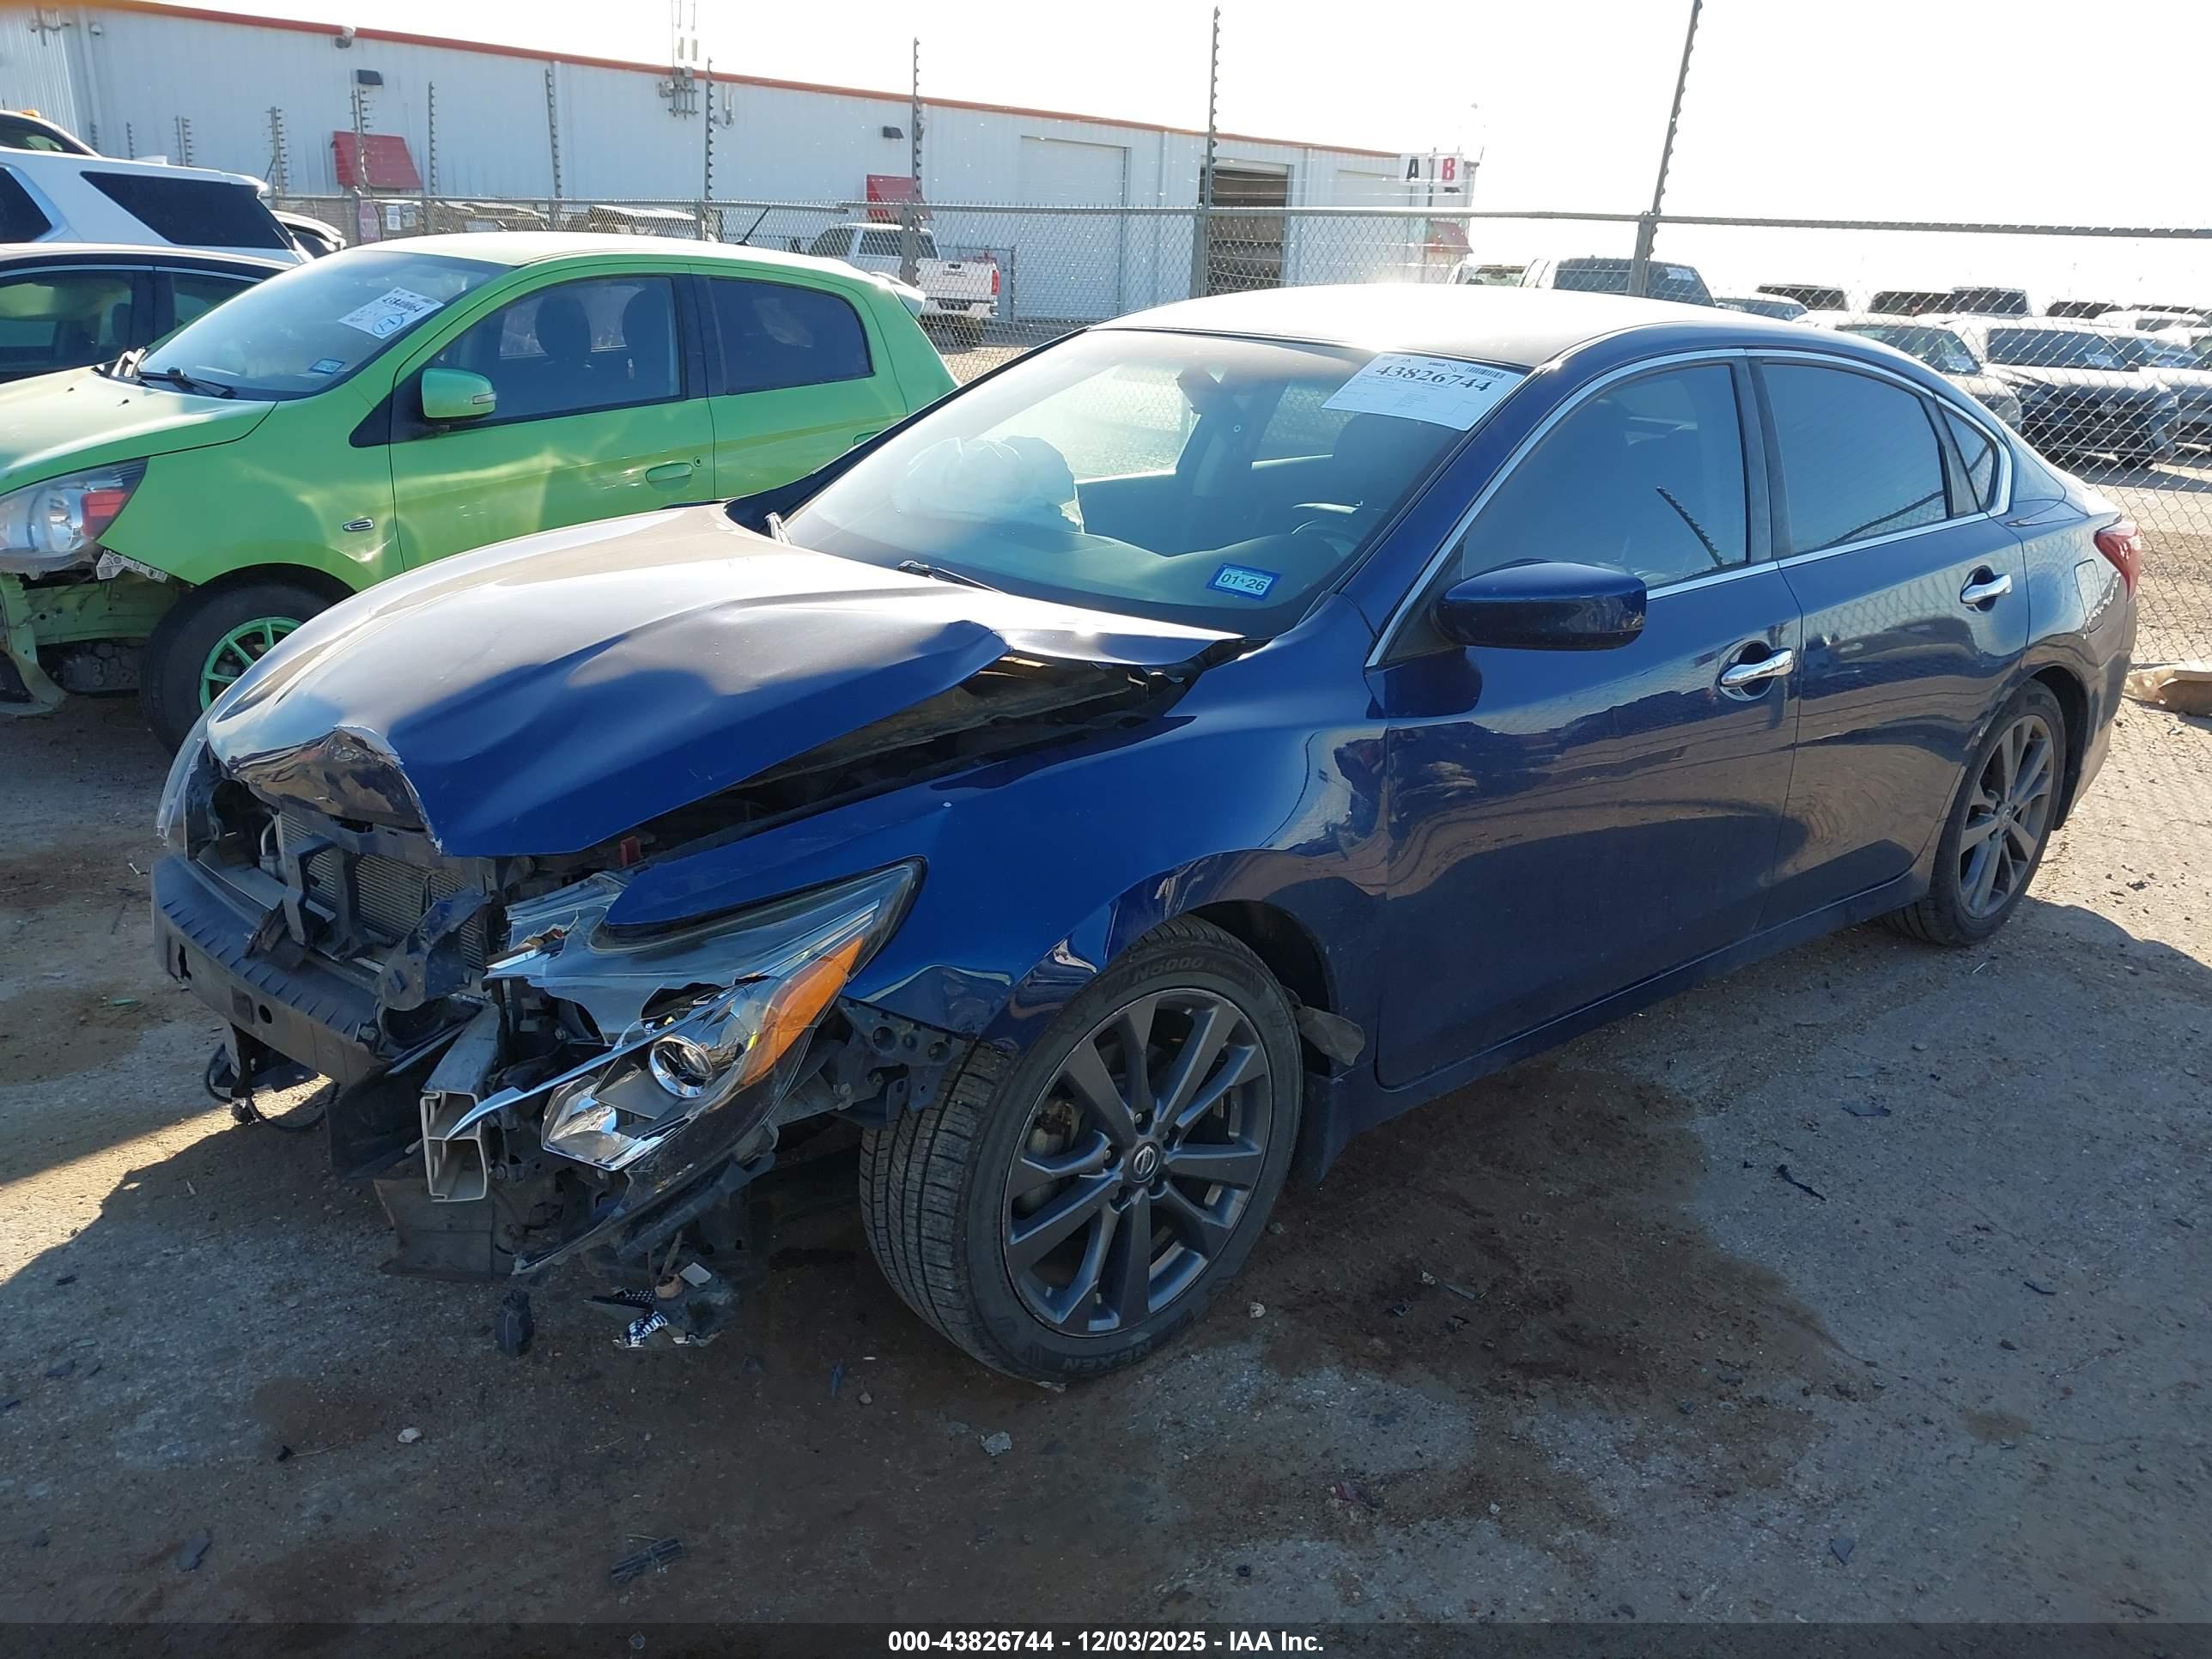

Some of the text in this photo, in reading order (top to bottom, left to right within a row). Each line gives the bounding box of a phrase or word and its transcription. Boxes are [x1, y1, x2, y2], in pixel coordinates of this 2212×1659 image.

[1406, 157, 1419, 182] A
[1442, 157, 1455, 181] B
[1375, 365, 1493, 392] 43826744
[1221, 574, 1267, 591] 01 26
